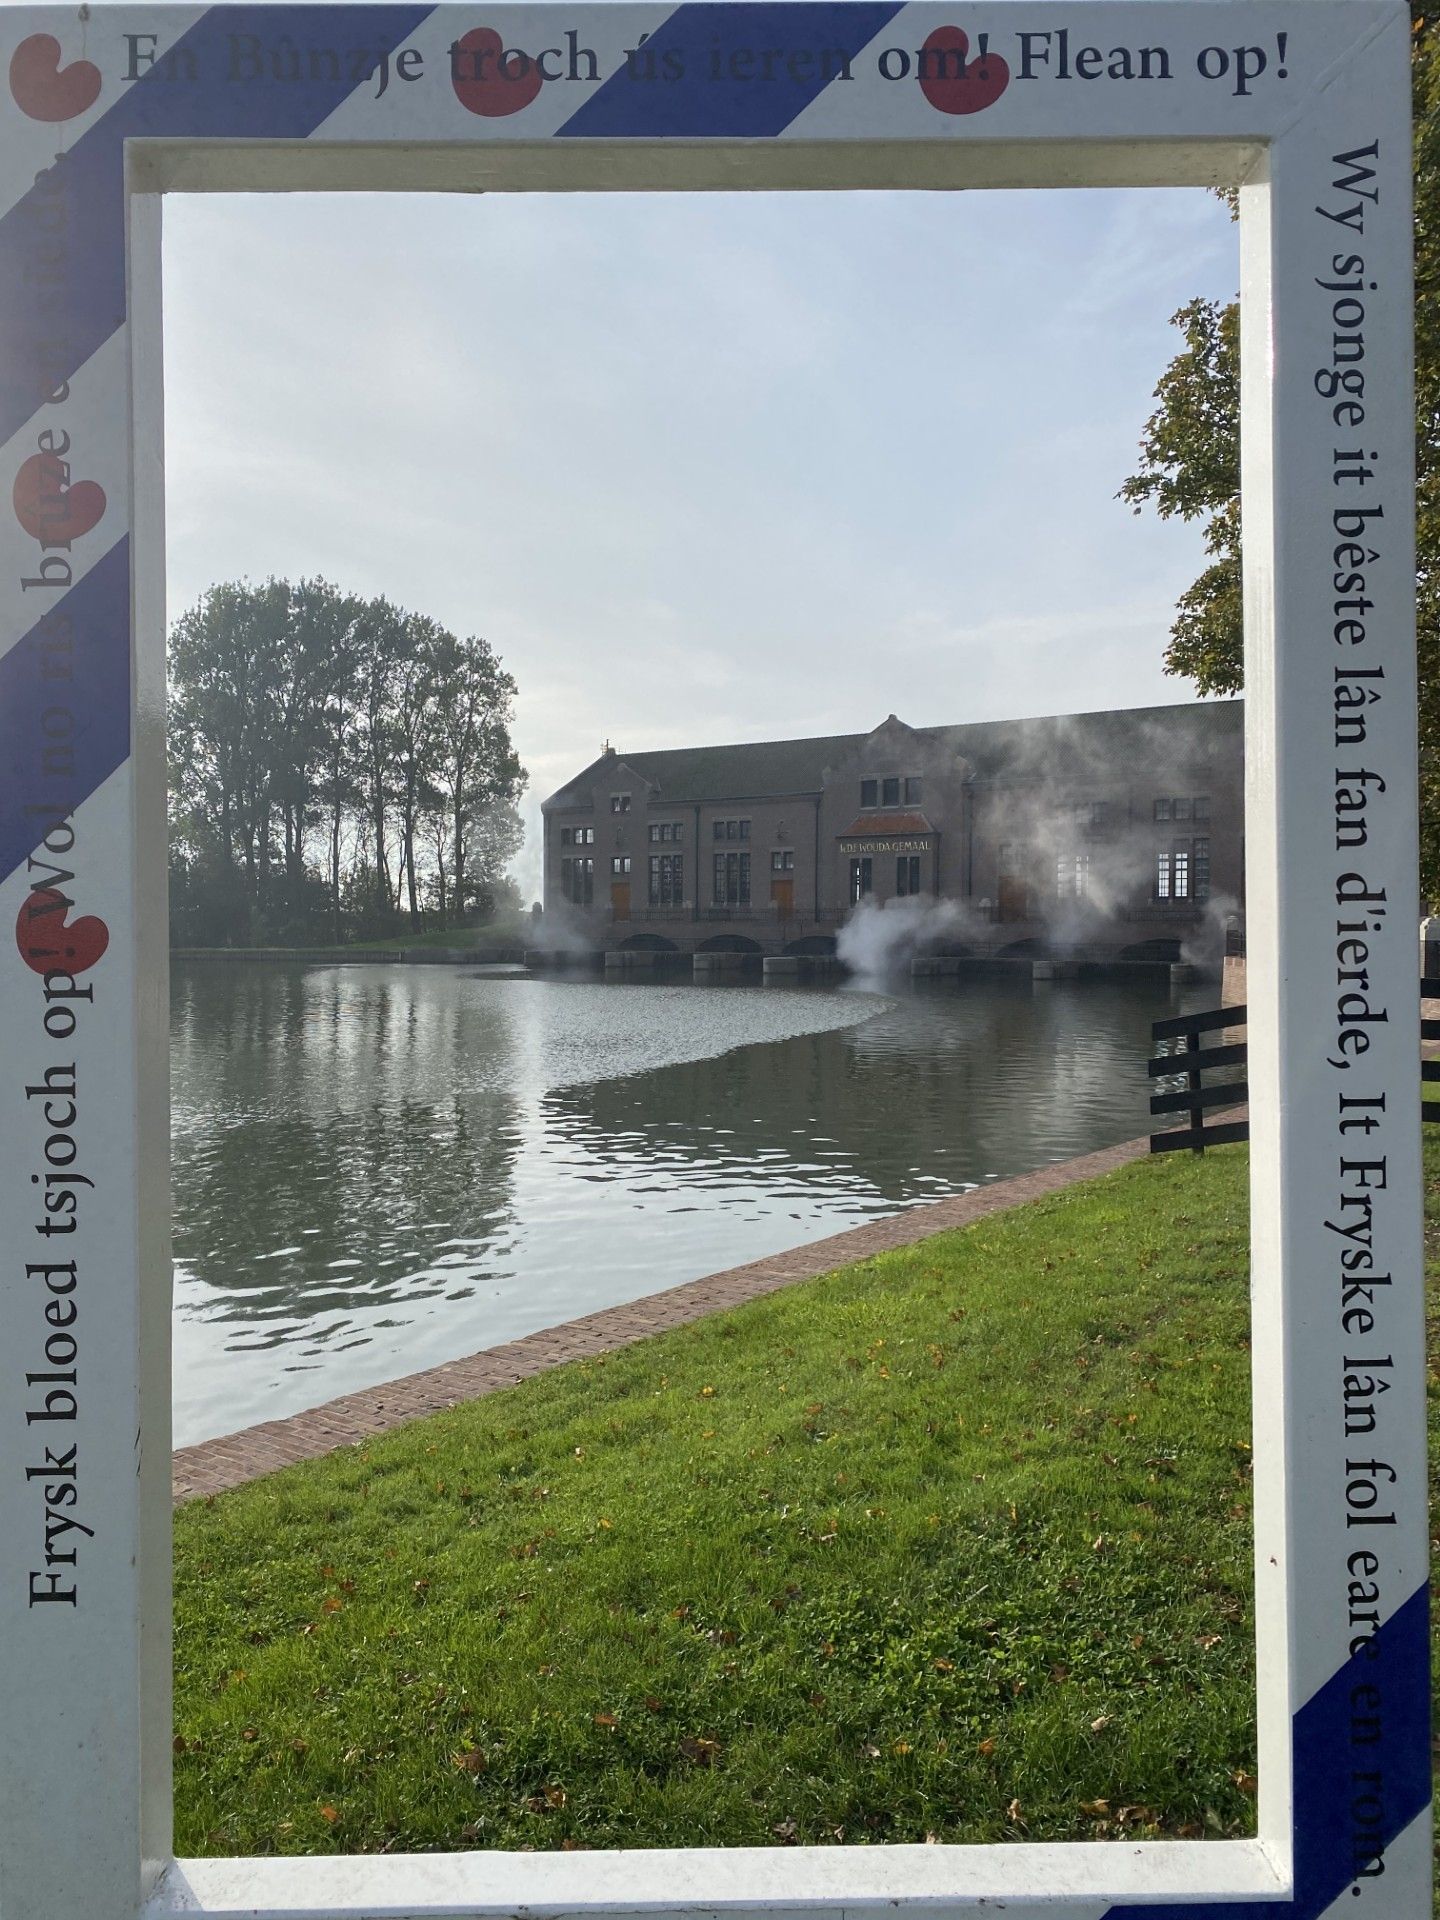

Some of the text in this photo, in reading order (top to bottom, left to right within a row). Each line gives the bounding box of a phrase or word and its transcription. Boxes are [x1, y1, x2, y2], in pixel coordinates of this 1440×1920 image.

[121, 34, 198, 81] En
[446, 29, 602, 81] troch
[623, 32, 686, 82] ús
[706, 32, 855, 81] ieren
[877, 33, 989, 80] om!
[1015, 28, 1174, 80] Flean
[1197, 32, 1289, 96] op!
[20, 430, 73, 592] brûze
[41, 707, 76, 778] no
[22, 805, 76, 922] Wol
[28, 946, 94, 1039] op!
[1314, 138, 1397, 1896] Wy sjonge it bêste lân fan d'ierde, It Fryske lân fol eare en rom.
[25, 1062, 95, 1238] tsjoch
[25, 1260, 77, 1426] bloed
[25, 1443, 95, 1608] Frysk
